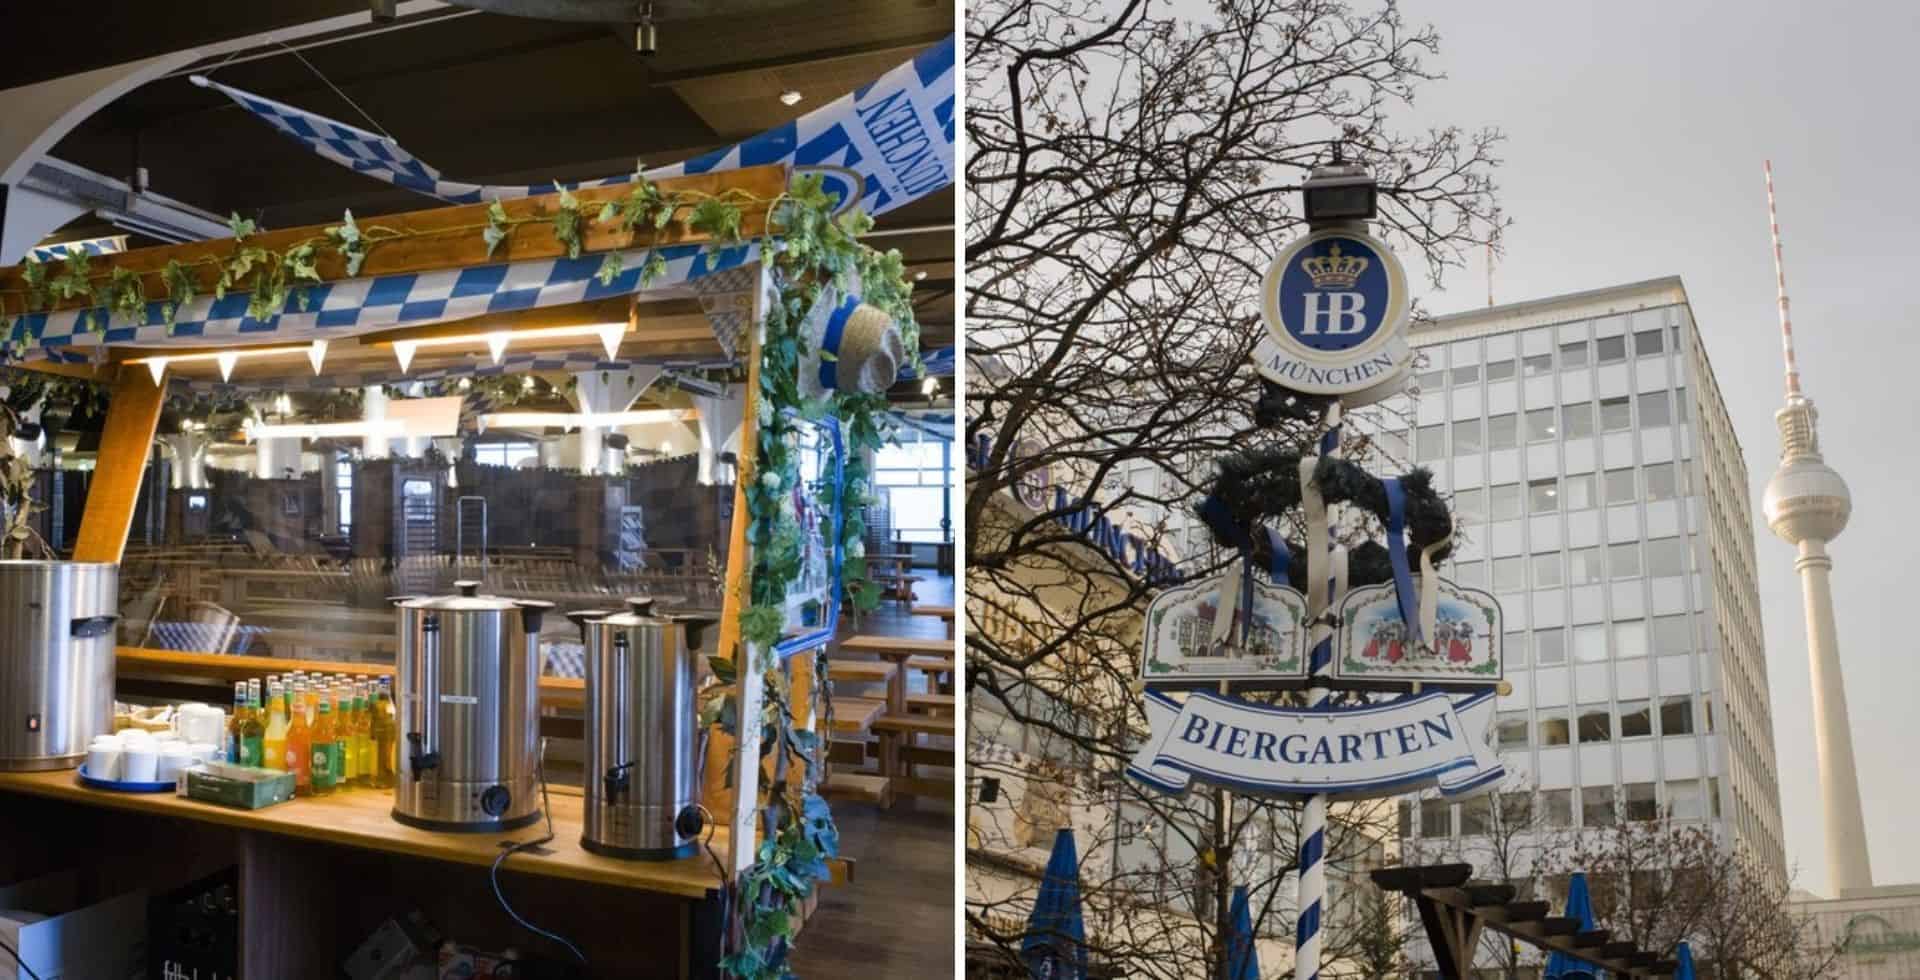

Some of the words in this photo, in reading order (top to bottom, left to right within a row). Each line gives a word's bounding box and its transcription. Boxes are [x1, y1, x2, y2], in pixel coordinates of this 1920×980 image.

[1300, 291, 1367, 335] HB
[1267, 352, 1393, 385] MÜNCHEN
[1179, 711, 1456, 765] BIERGARTEN
